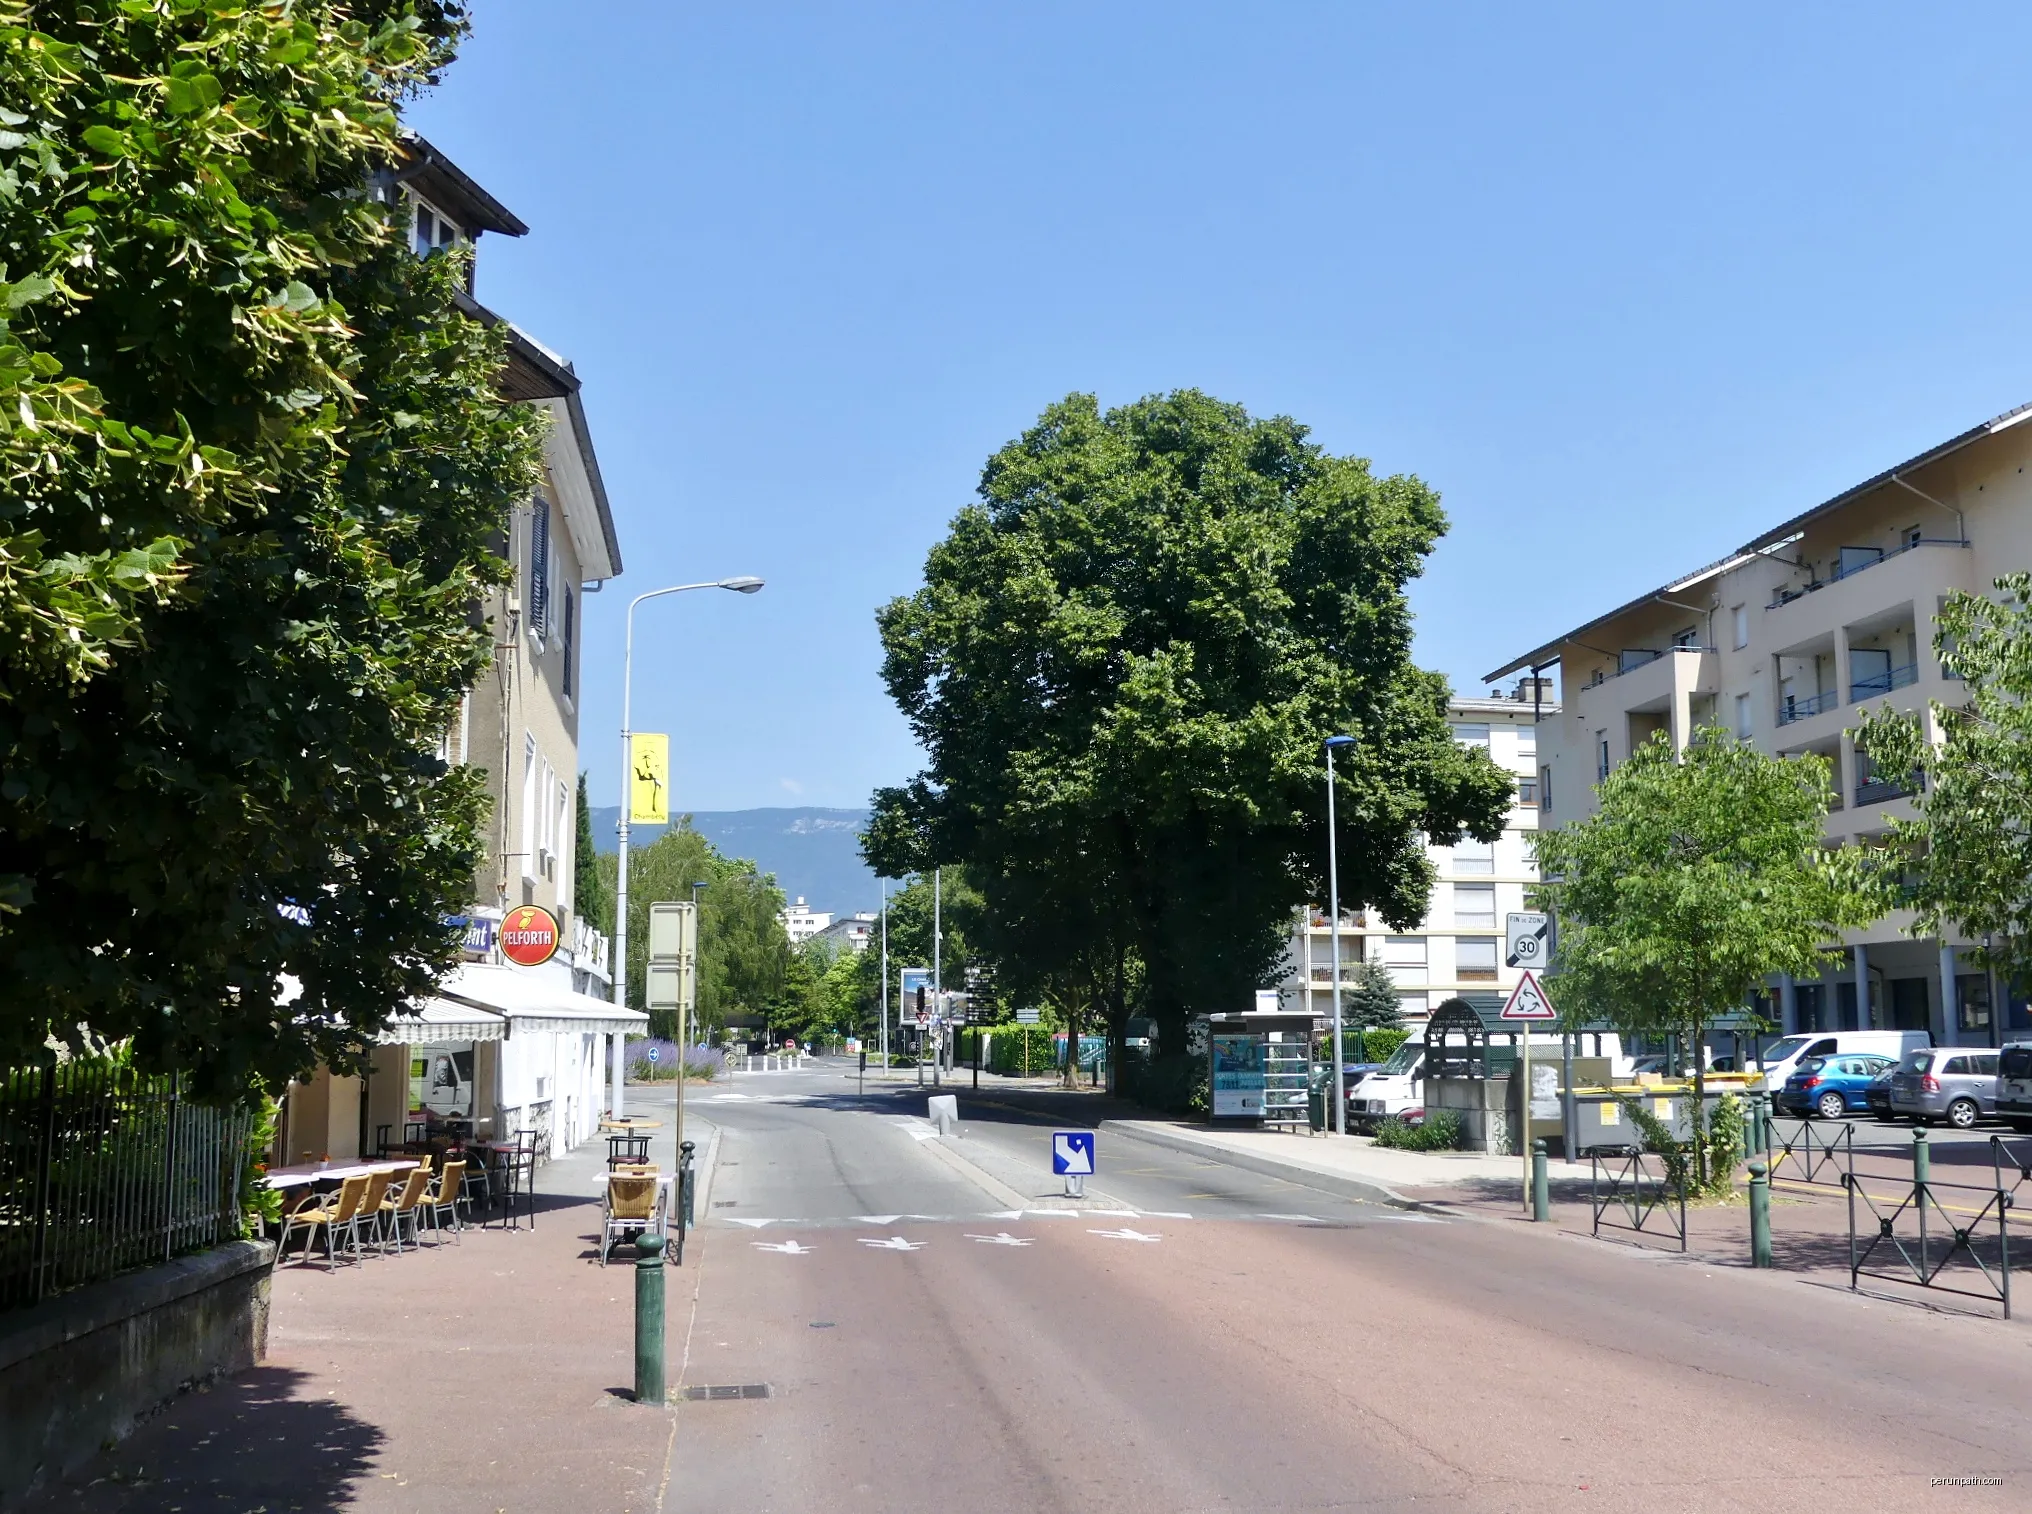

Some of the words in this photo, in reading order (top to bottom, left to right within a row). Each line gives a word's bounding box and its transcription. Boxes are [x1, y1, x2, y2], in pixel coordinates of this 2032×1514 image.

[1528, 916, 1545, 924] ZONE
[503, 930, 552, 945] PELFORTH
[1519, 941, 1535, 953] 30
